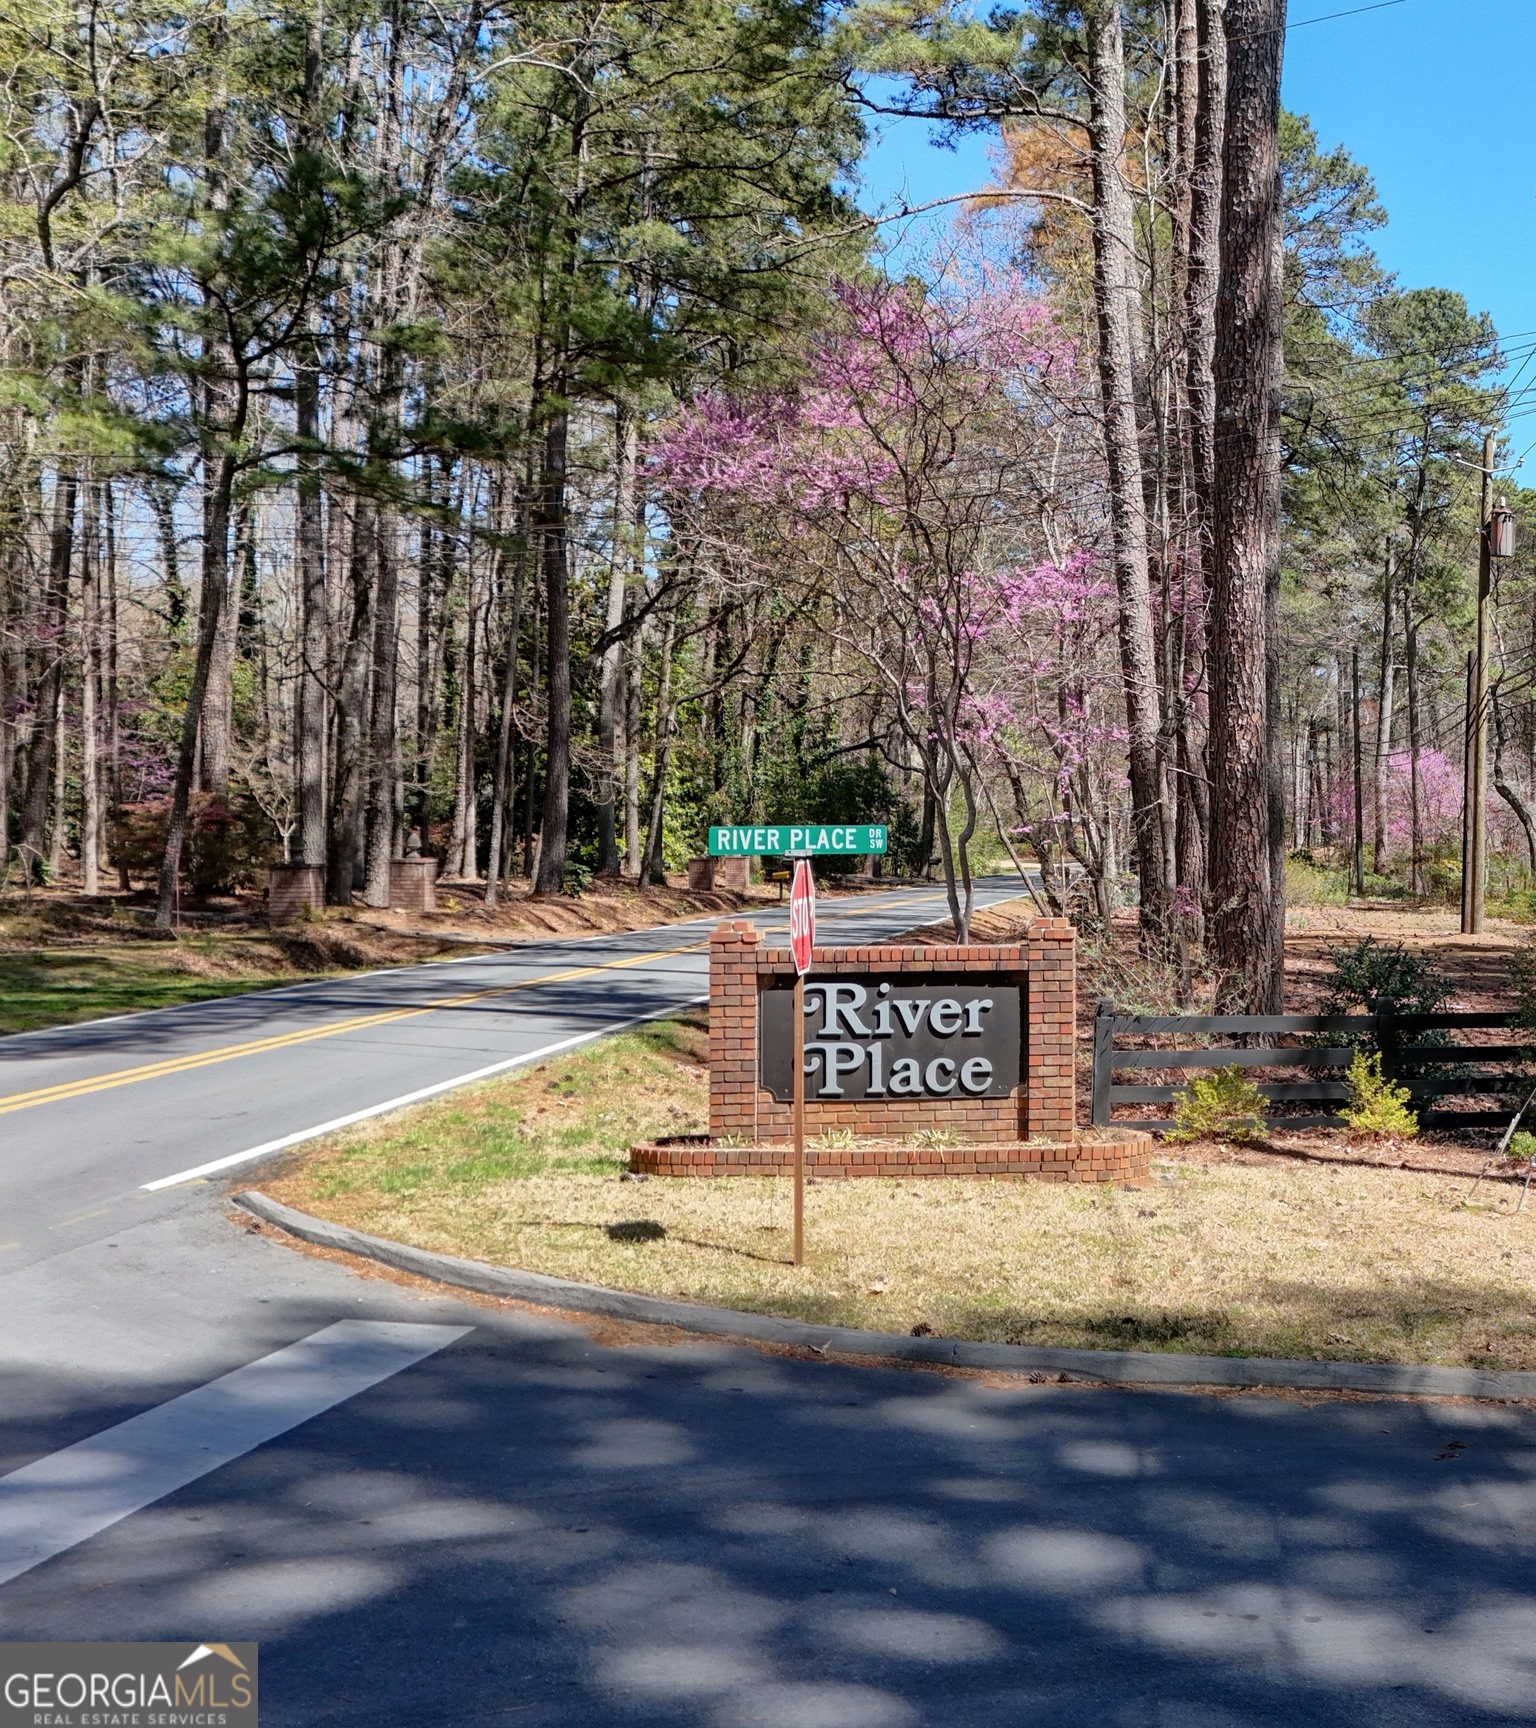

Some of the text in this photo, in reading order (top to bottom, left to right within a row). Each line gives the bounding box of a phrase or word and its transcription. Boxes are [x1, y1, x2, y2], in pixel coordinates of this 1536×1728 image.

[717, 828, 882, 851] RIVER PLACE DR
[869, 838, 883, 849] SW
[792, 896, 813, 940] STOP
[802, 982, 993, 1036] River
[802, 1042, 993, 1095] Place
